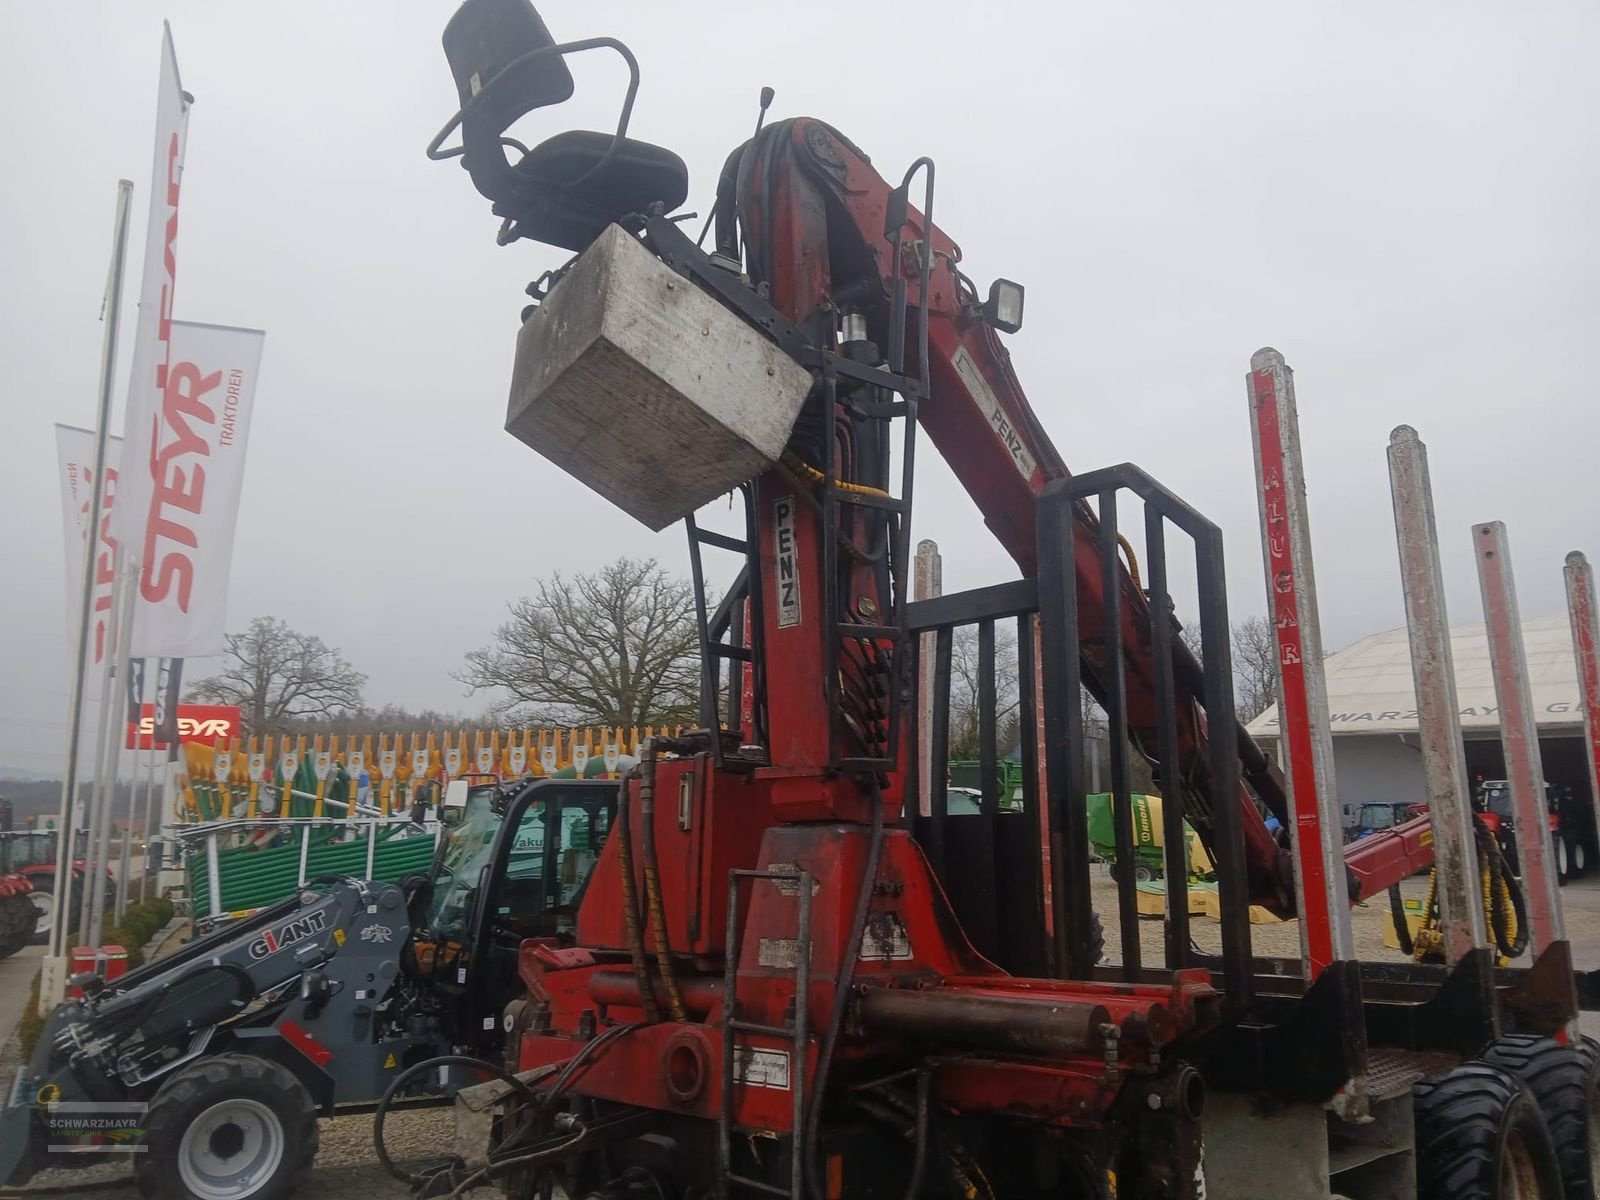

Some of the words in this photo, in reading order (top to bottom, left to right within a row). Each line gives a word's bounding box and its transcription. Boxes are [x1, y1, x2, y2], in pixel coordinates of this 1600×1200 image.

[220, 369, 243, 447] TRAKTOREN
[992, 408, 1022, 459] PENZ
[140, 361, 222, 614] STEYR
[776, 502, 795, 608] PENZ
[135, 717, 231, 737] SEYR
